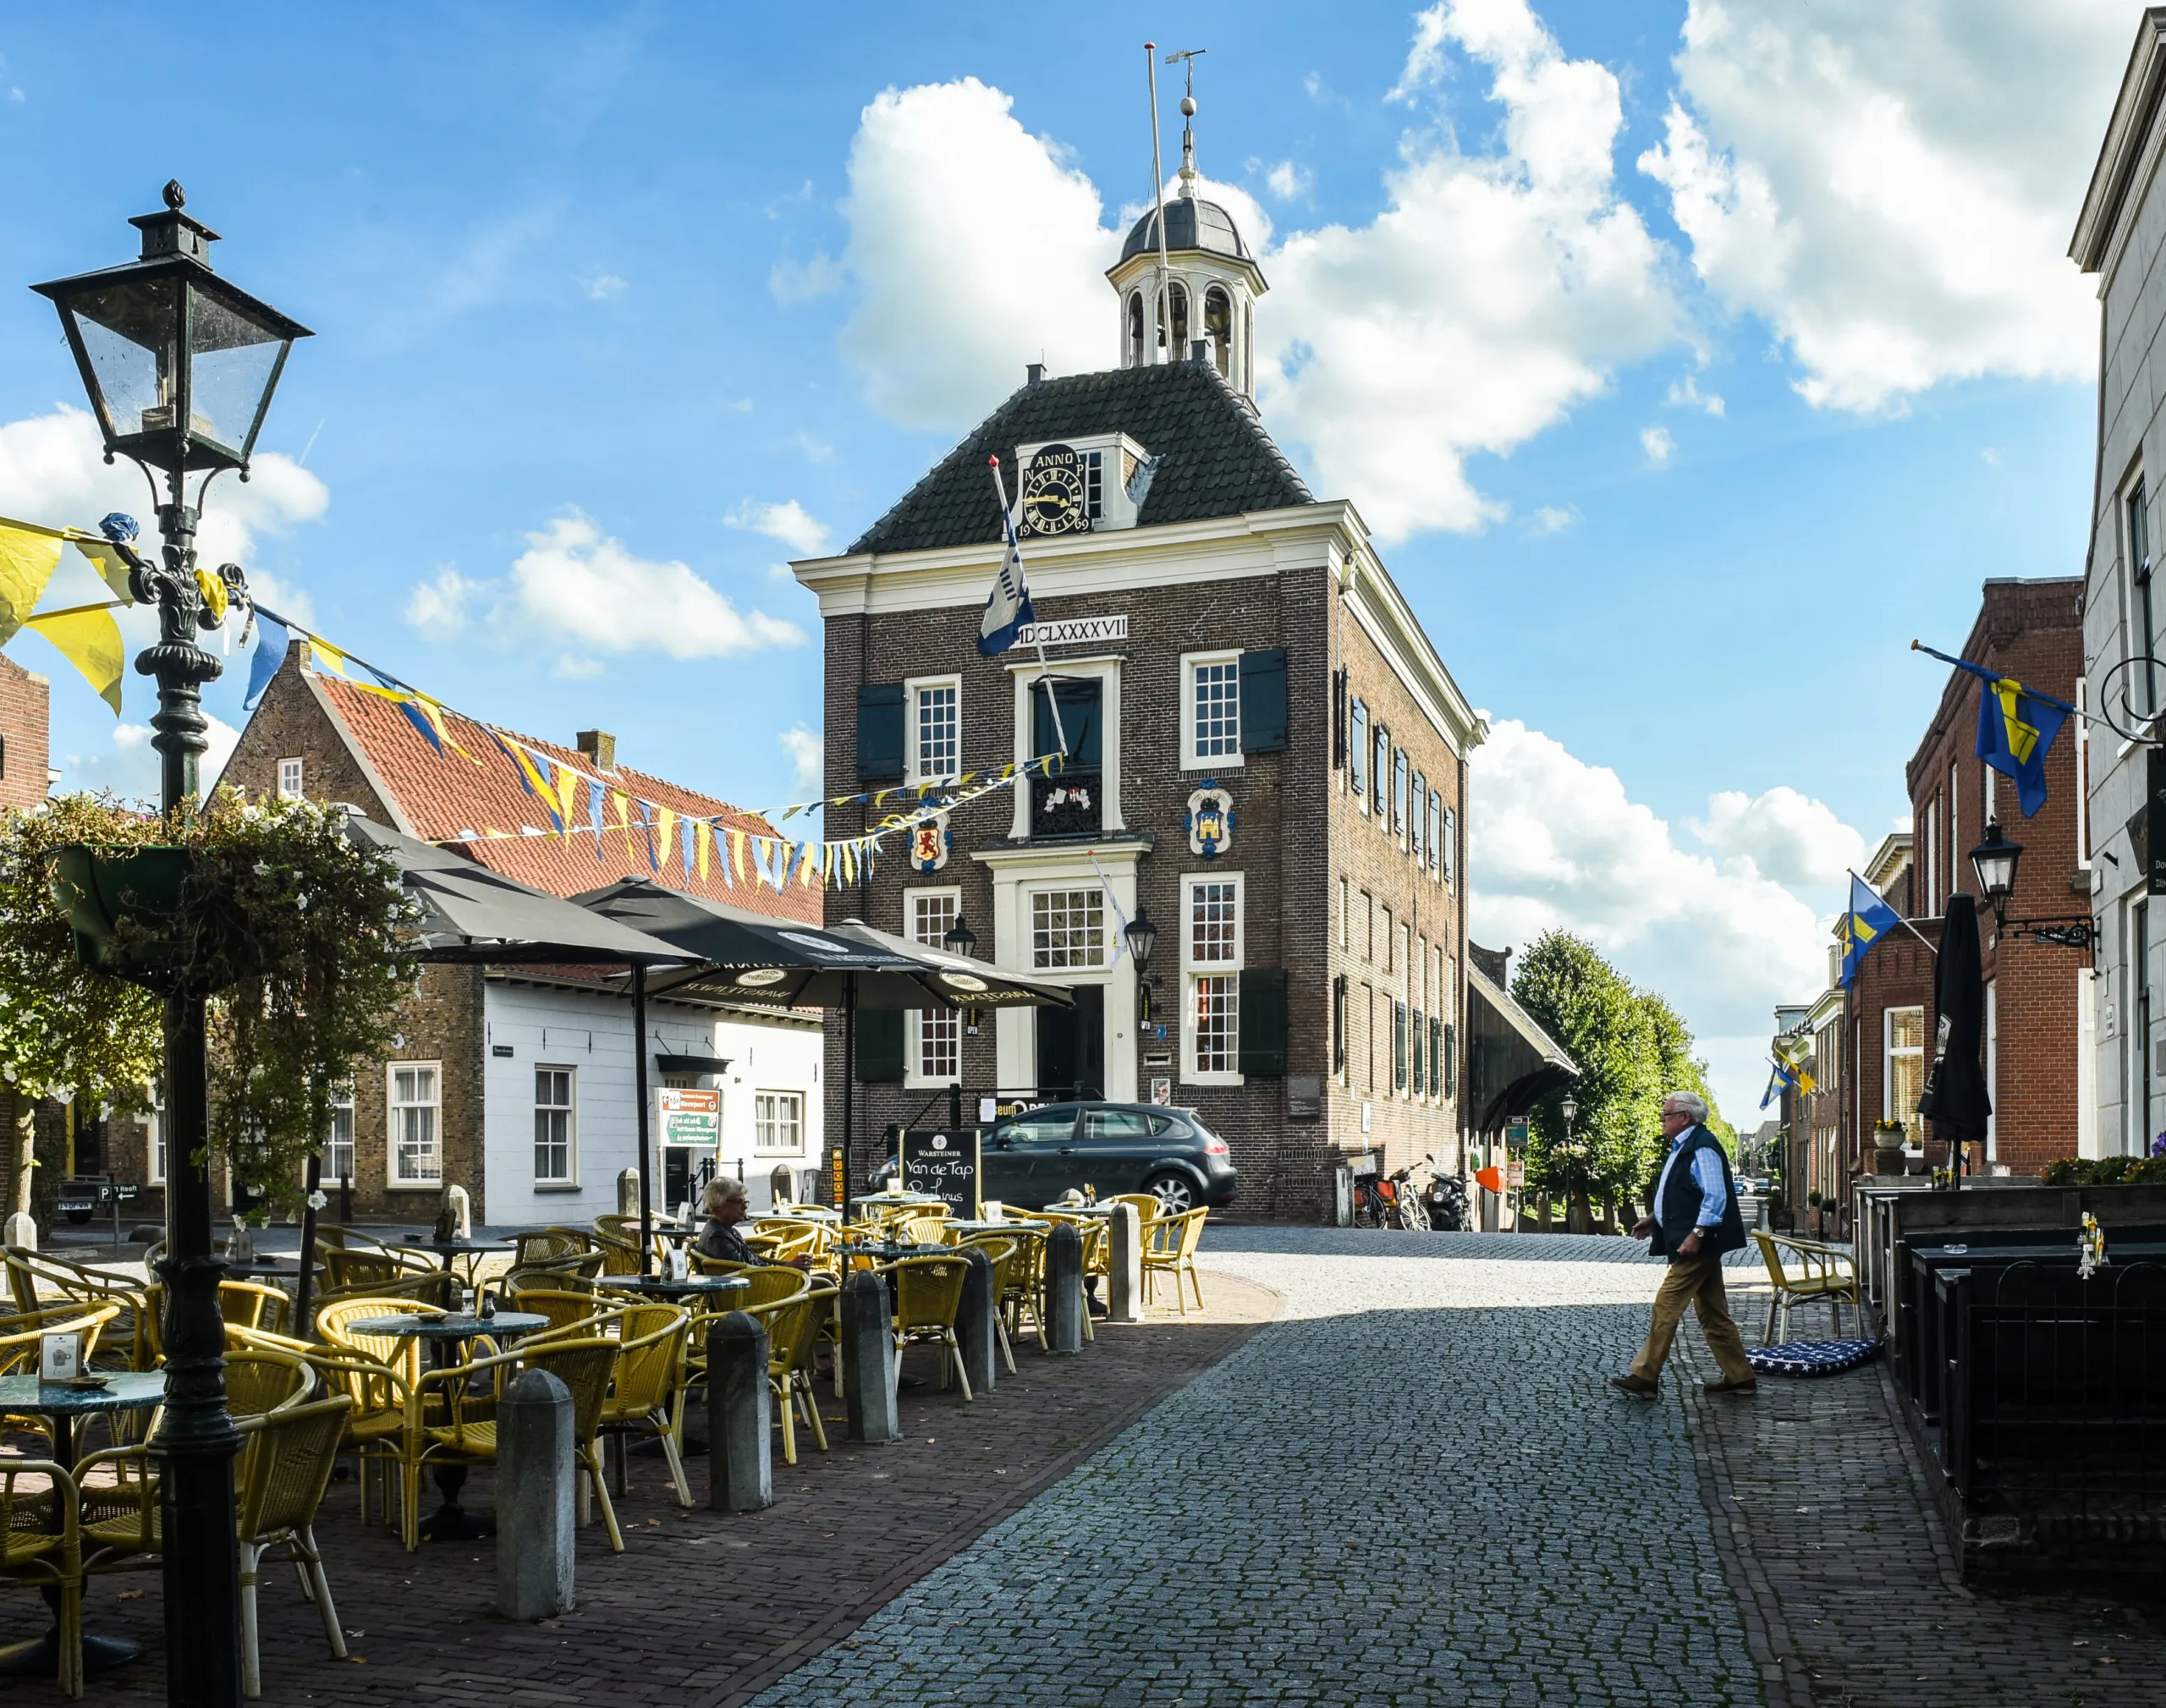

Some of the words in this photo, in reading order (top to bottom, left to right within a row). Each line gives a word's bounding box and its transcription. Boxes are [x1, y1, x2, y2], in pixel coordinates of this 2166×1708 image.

[1036, 453, 1073, 467] ANNO
[1020, 524, 1031, 536] 19
[1075, 518, 1089, 530] 69
[2155, 860, 2166, 869] Do
[906, 1158, 928, 1175] Van
[931, 1163, 947, 1175] de
[947, 1161, 974, 1179] Tap
[102, 1188, 109, 1199] P
